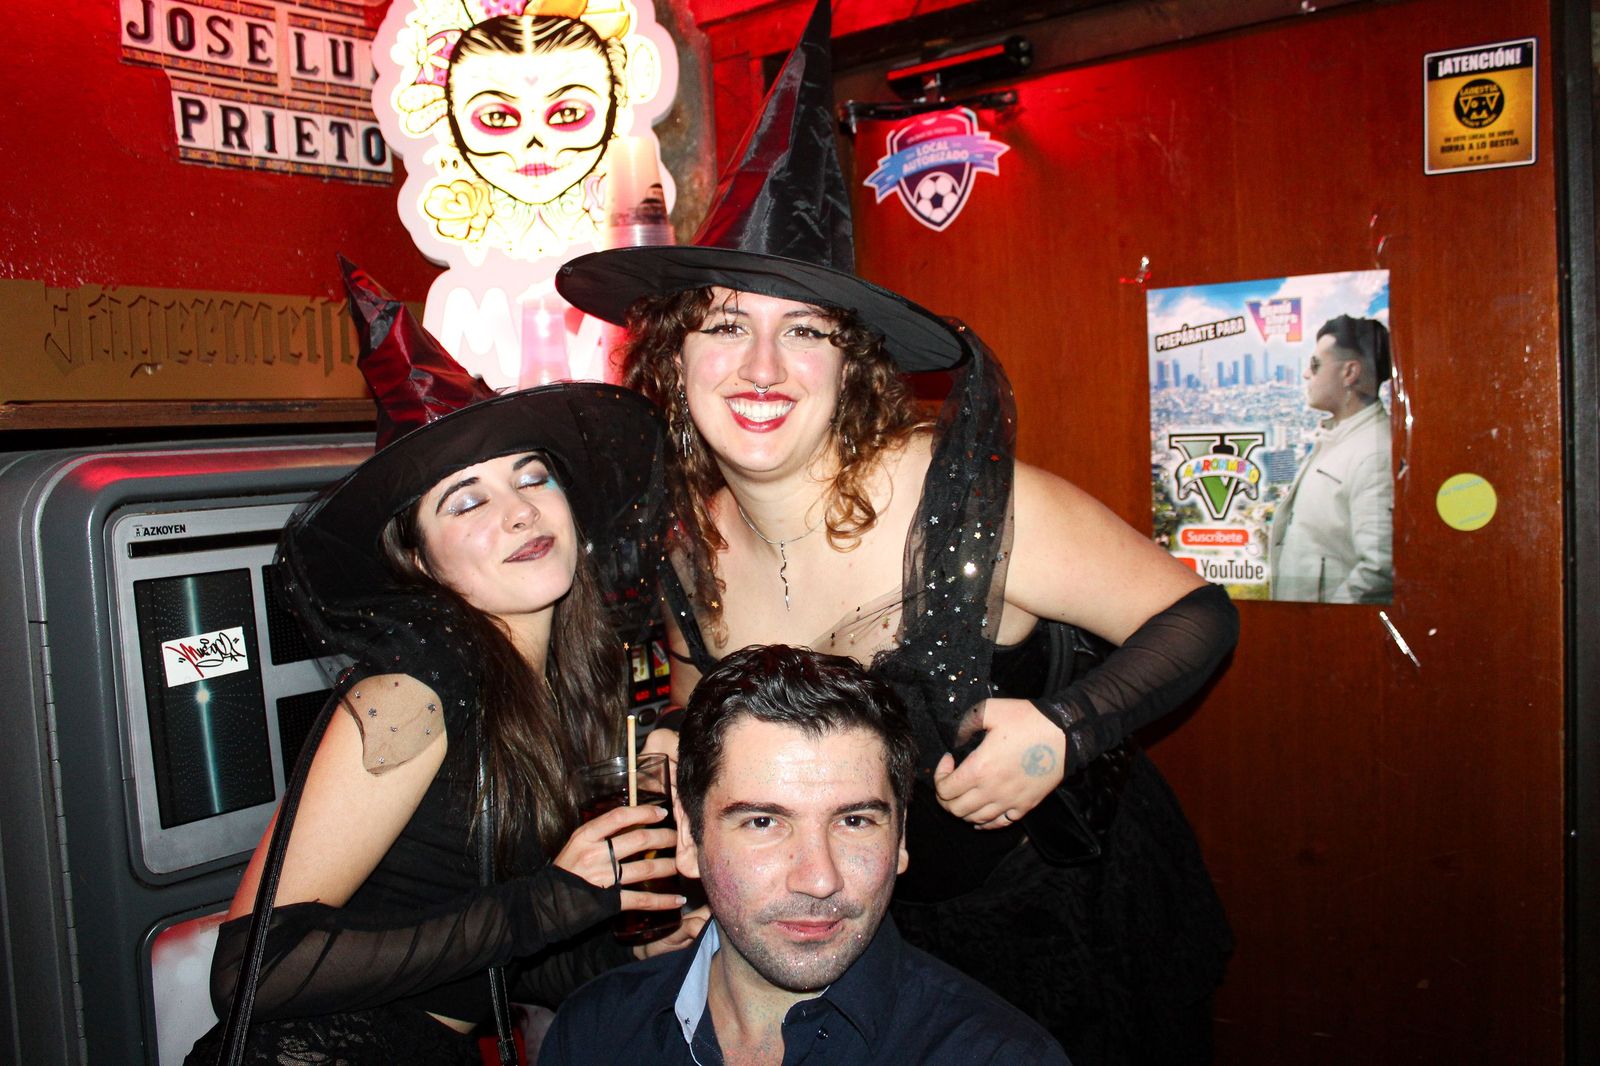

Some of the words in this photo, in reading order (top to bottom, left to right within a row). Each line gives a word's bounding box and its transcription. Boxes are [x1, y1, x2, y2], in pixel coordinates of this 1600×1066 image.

[126, 0, 273, 66] JOSE
[294, 32, 379, 84] LU
[1438, 47, 1521, 77] ¡ATENCIÓN!
[177, 96, 386, 167] PRIETO
[902, 149, 969, 175] AUTORIZADO
[916, 140, 949, 156] LOCAL
[1155, 323, 1216, 352] PREPÁRATE
[1216, 316, 1245, 339] PARA
[143, 523, 186, 537] AZKOYEN
[1201, 559, 1264, 580] YouTube
